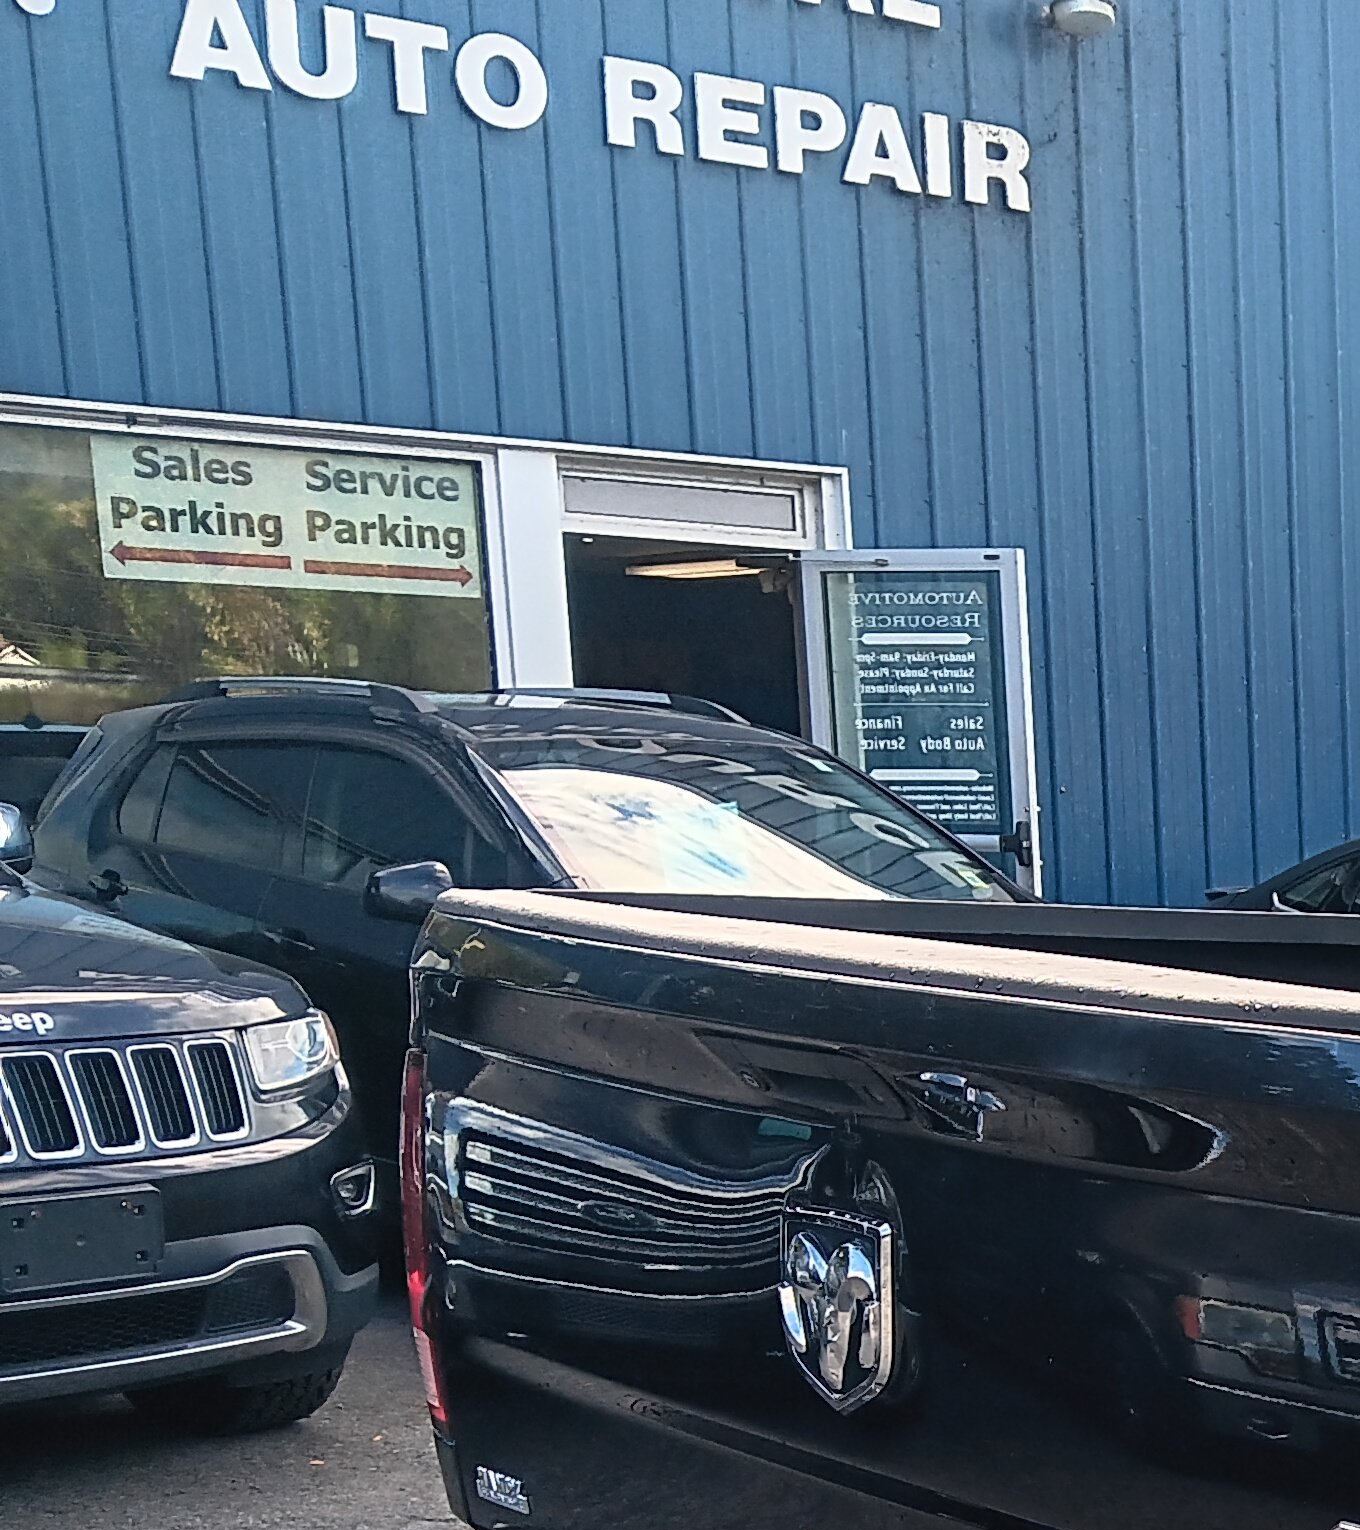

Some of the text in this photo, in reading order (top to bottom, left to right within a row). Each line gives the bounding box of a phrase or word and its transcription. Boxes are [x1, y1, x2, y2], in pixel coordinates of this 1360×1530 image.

[170, 0, 1031, 212] AUTO REPAIR
[132, 445, 253, 486] Sales
[305, 459, 460, 502] Service
[111, 496, 283, 547] Parking
[306, 509, 466, 559] Parking
[0, 1011, 54, 1036] eep
